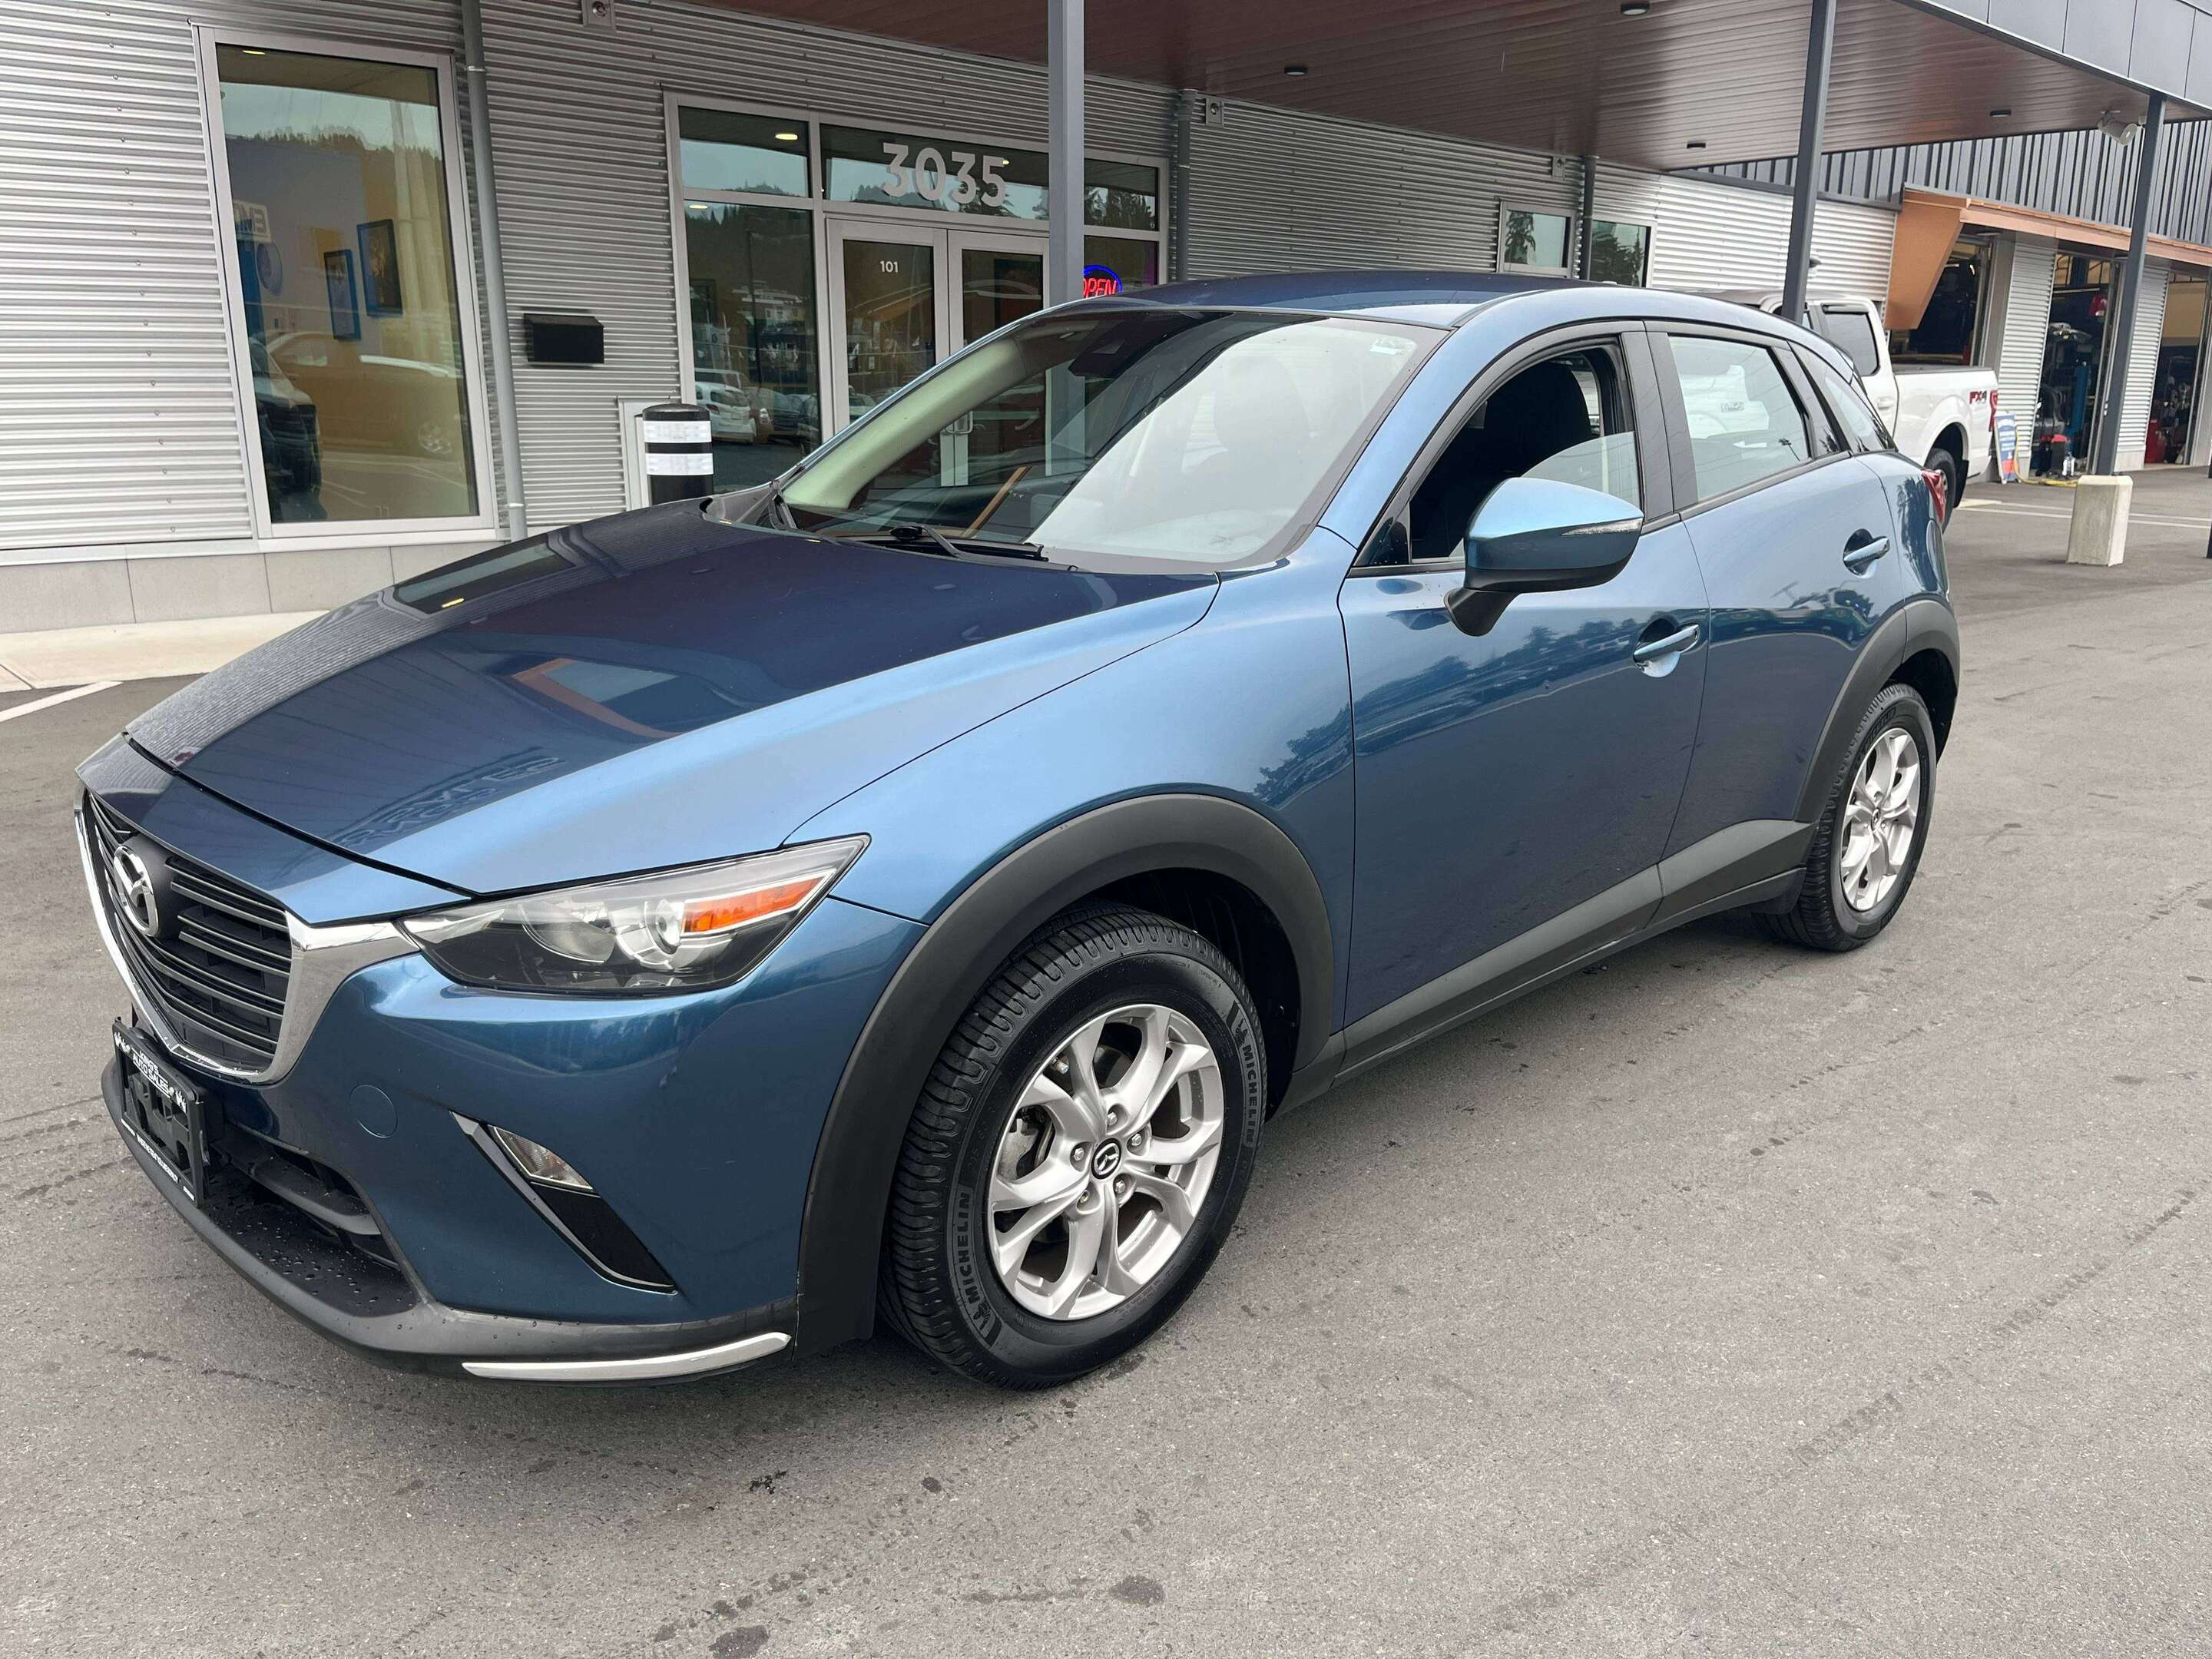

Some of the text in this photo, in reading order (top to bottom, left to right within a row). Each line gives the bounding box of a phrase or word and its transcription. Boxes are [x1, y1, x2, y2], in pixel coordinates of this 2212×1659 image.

[882, 142, 1007, 207] 3035
[880, 260, 899, 273] 101
[1969, 390, 1988, 404] FX4
[133, 1053, 170, 1095] AUTO SALES
[1242, 1044, 1258, 1144] MICHELIN
[957, 1192, 982, 1304] MICHELIN
